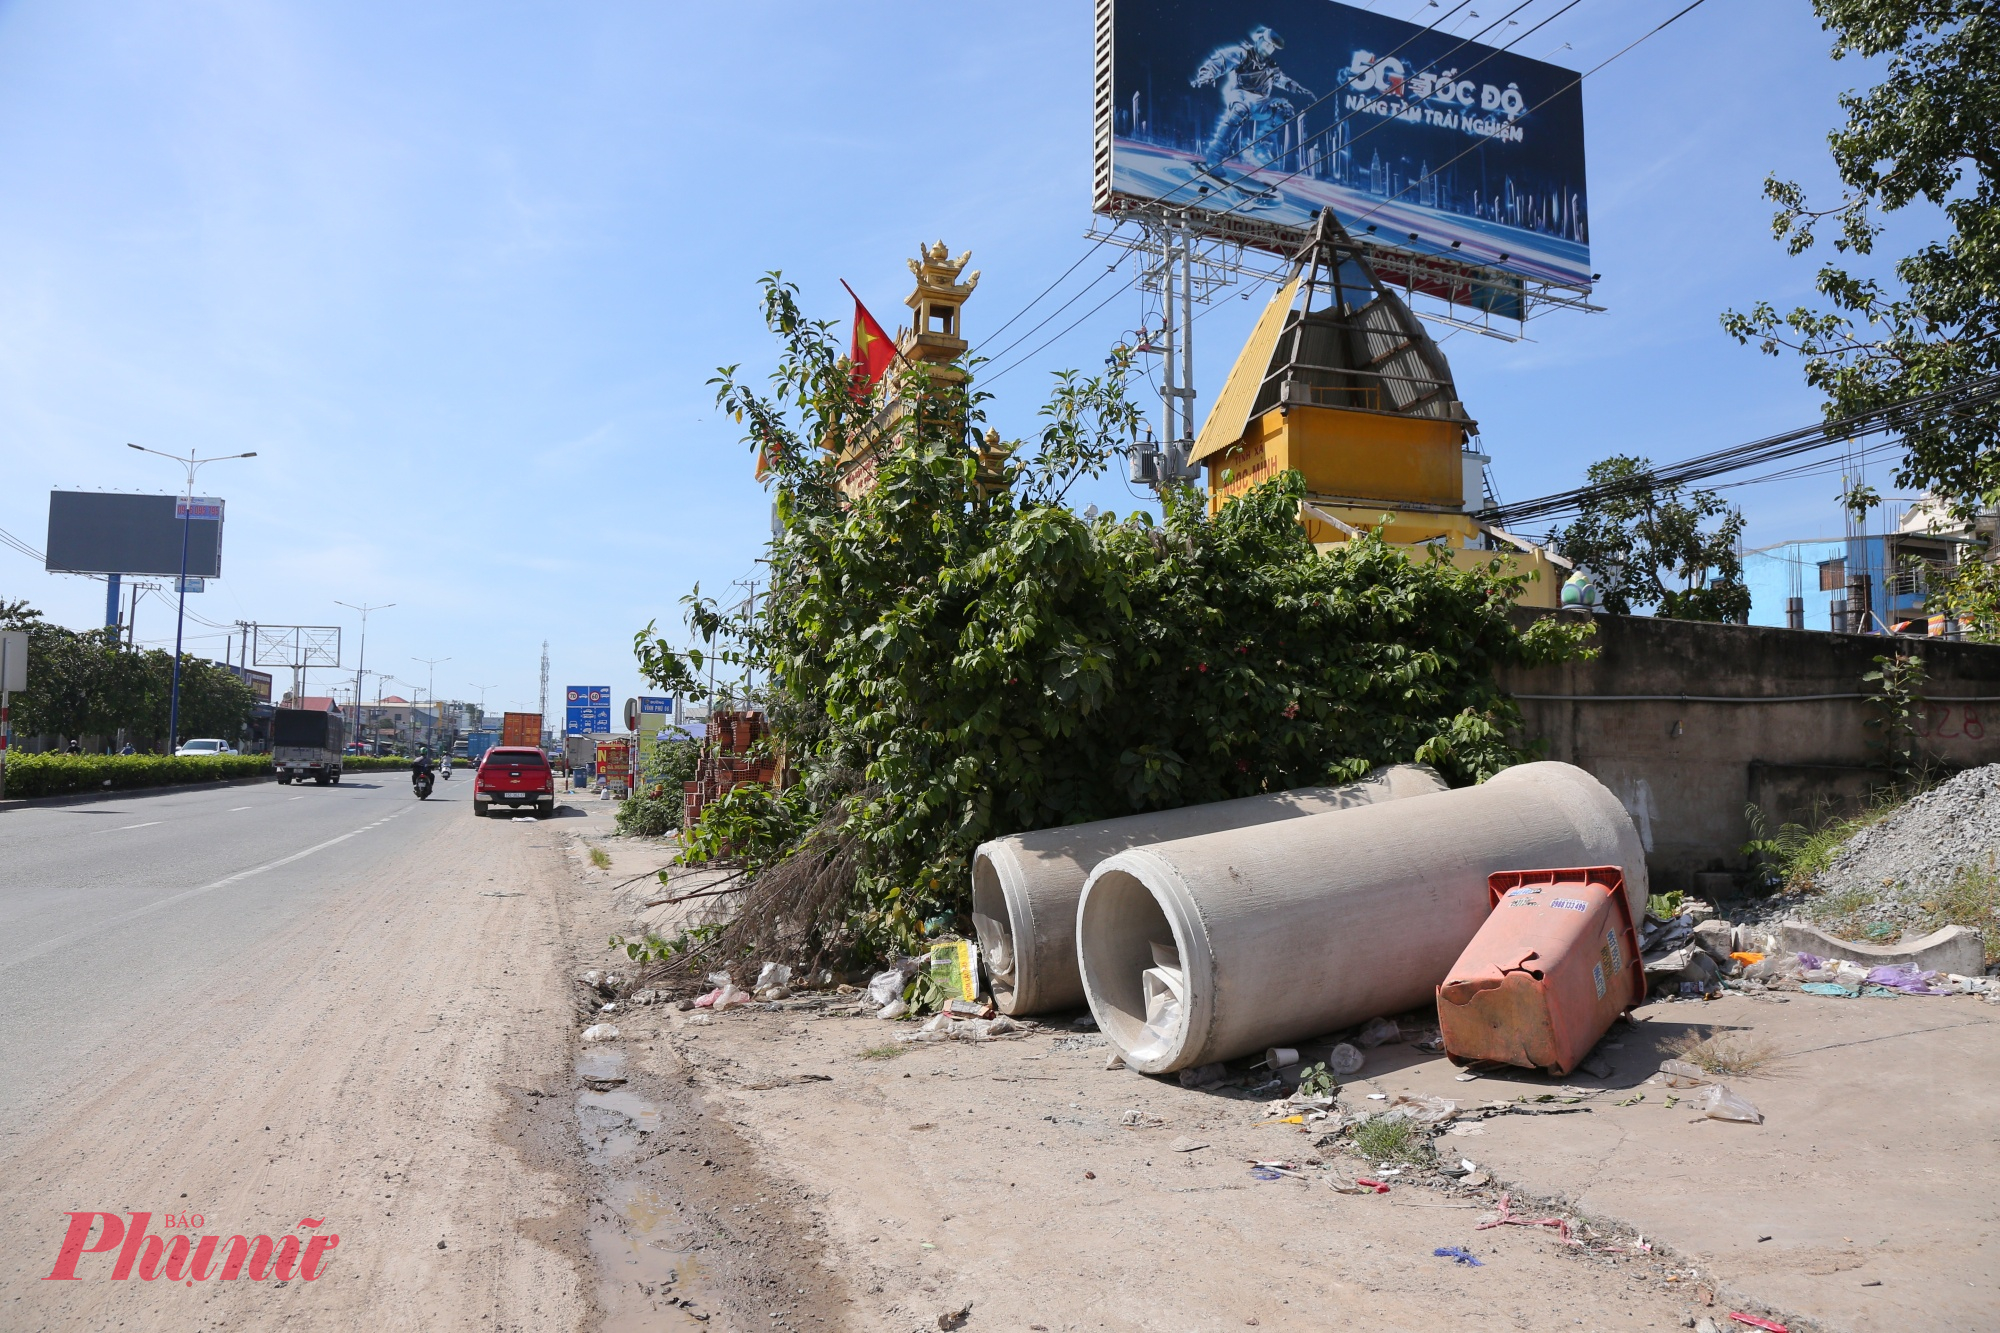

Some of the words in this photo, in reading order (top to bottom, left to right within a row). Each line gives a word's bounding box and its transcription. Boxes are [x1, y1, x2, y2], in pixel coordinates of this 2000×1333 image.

[1347, 49, 1405, 97] 5G
[1409, 68, 1476, 106] TỐC
[1481, 82, 1524, 121] ĐỘ
[1345, 94, 1388, 116] NÂNG
[1389, 99, 1423, 123] TẦM
[1424, 108, 1459, 129] TRẢI
[1461, 117, 1524, 144] NGHIỆM
[592, 693, 599, 701] 60
